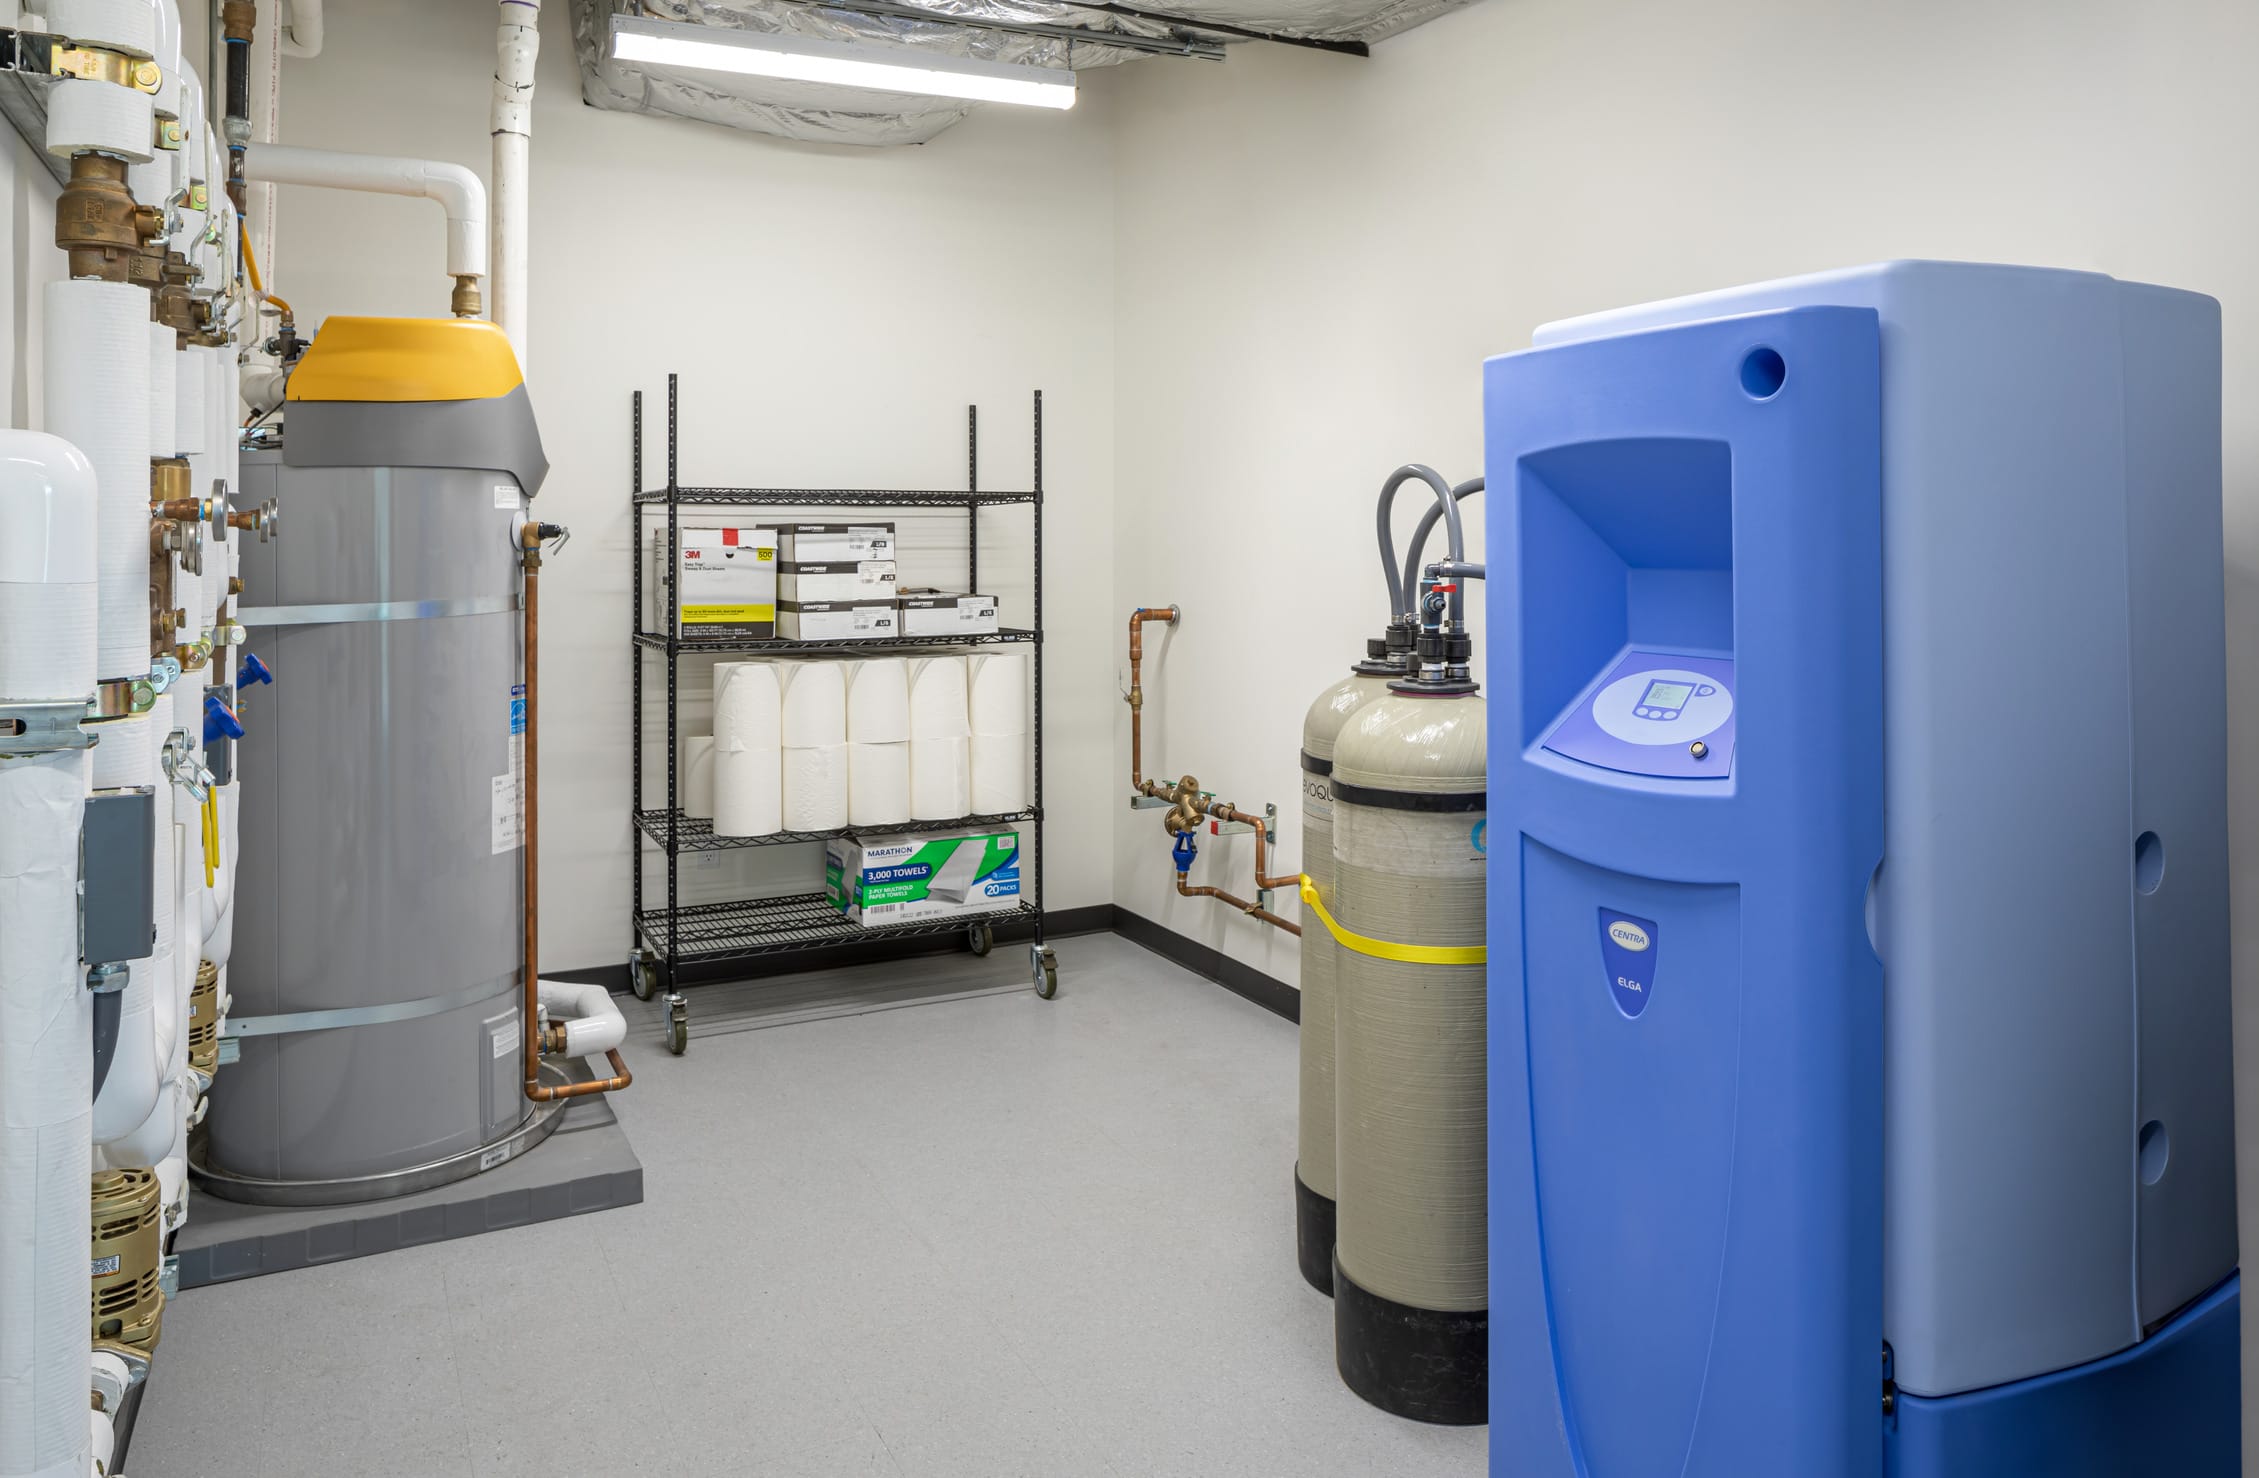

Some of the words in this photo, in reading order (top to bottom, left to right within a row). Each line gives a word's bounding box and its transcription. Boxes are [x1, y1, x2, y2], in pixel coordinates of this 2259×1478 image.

[685, 550, 701, 559] 3M
[868, 847, 913, 857] MARATHON
[868, 871, 892, 880] 3,000
[884, 885, 914, 893] MULTIFOLD
[986, 884, 1000, 896] 20
[1000, 884, 1017, 892] PACKS
[1613, 929, 1645, 944] CENTRA
[1618, 977, 1642, 992] ELGA
